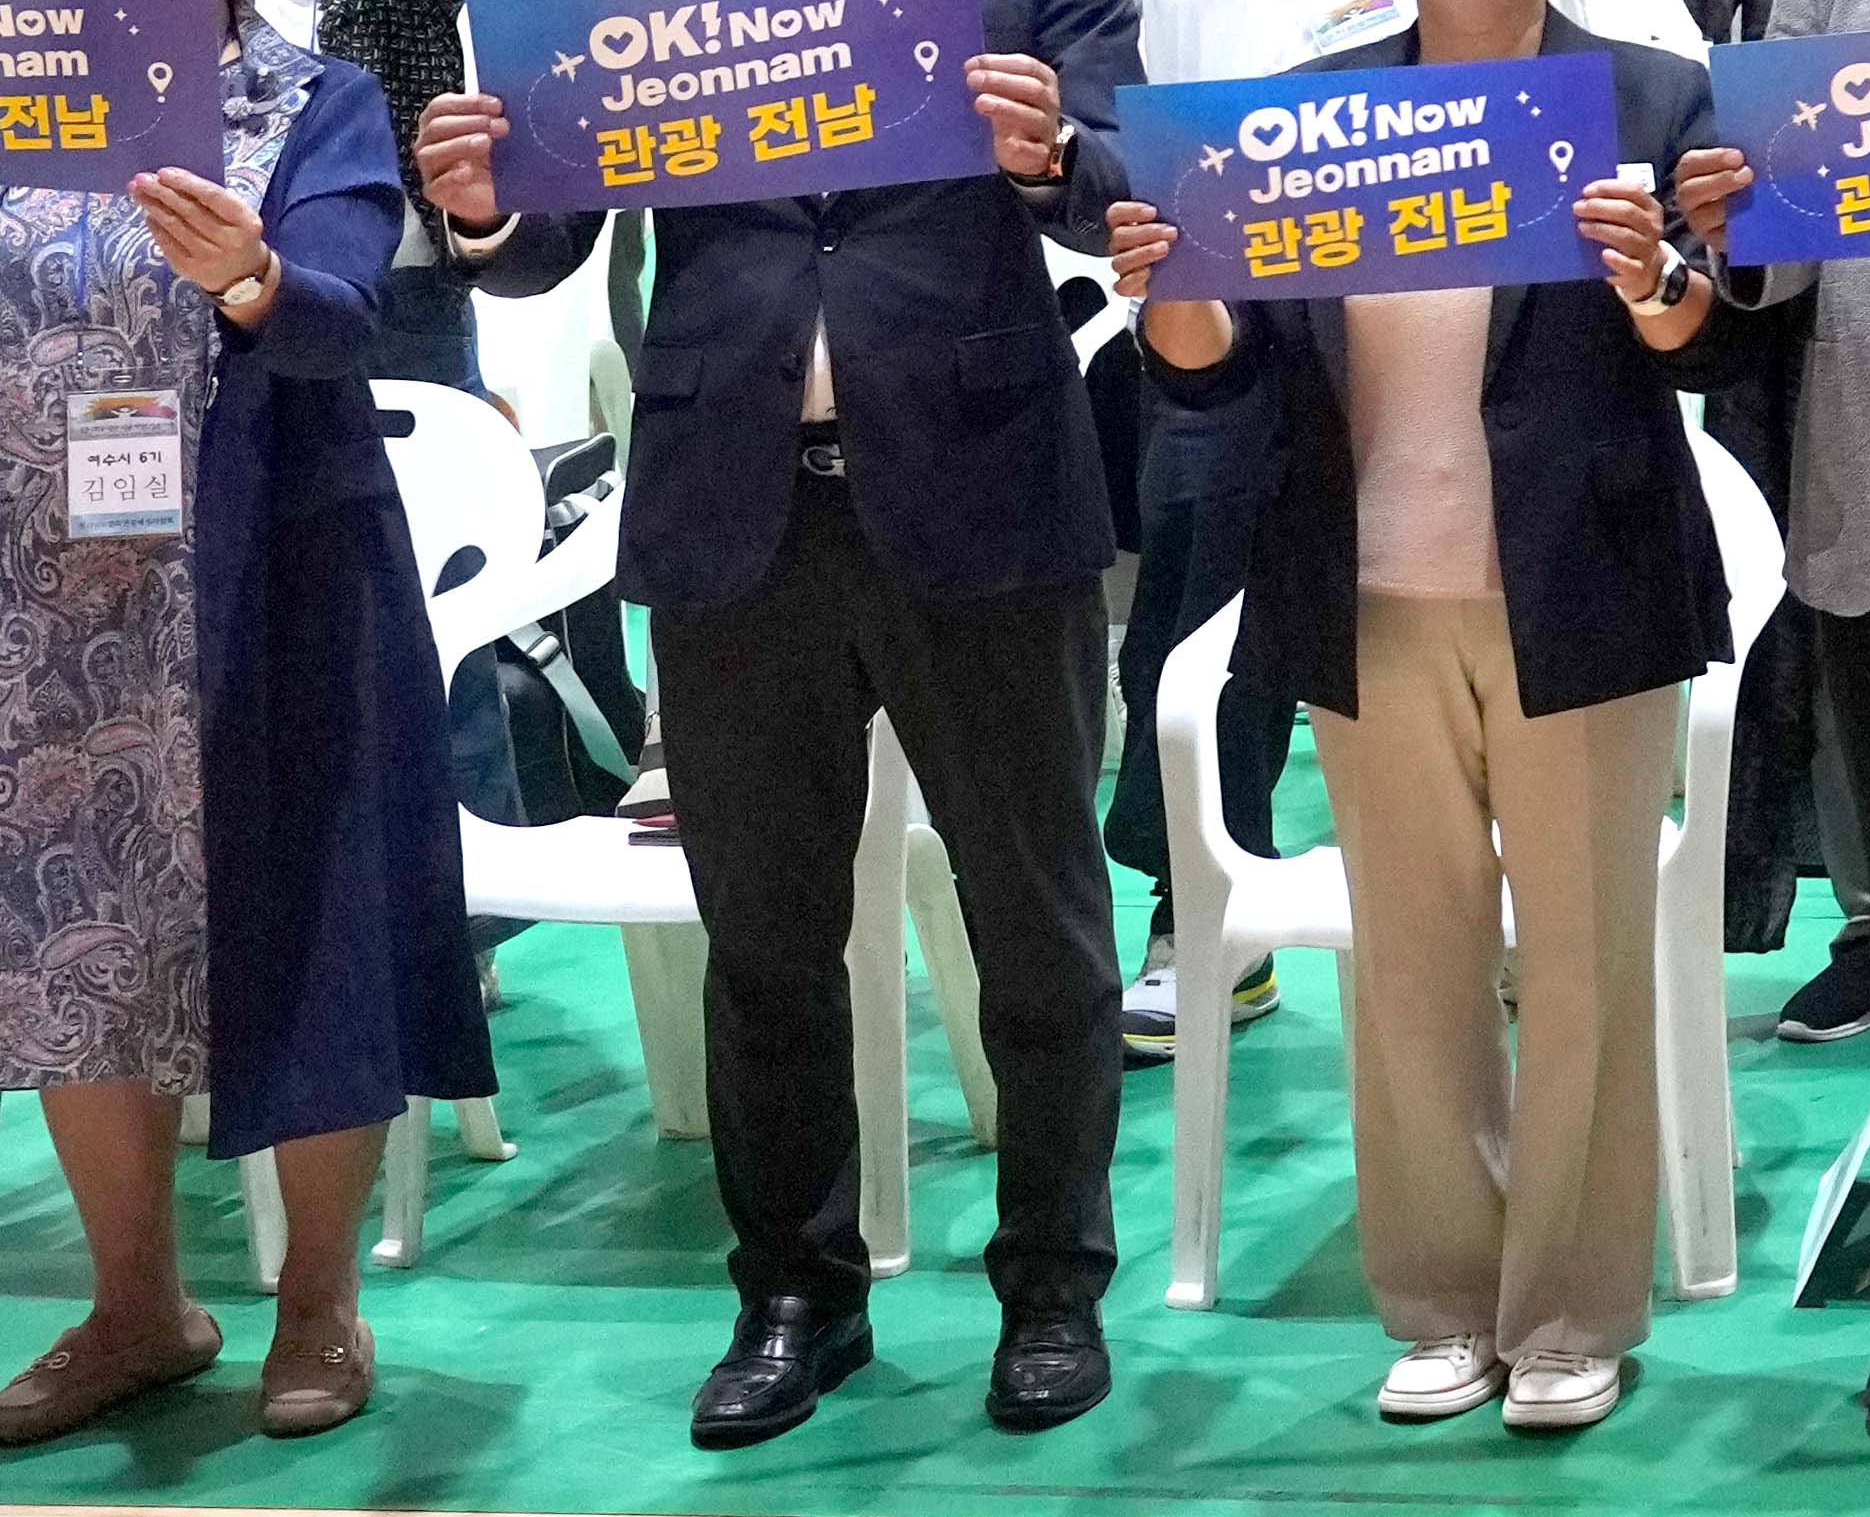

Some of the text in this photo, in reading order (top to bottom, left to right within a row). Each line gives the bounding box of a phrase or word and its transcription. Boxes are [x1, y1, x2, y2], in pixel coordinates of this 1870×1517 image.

[590, 0, 845, 69] OK! Now
[602, 43, 851, 111] Jeonnam
[597, 84, 875, 186] 관광 전남
[1239, 93, 1486, 161] OK! Now
[1250, 139, 1489, 203] Jeonnam
[1243, 181, 1511, 277] 관광 전남
[87, 451, 162, 467] 여수시 6기
